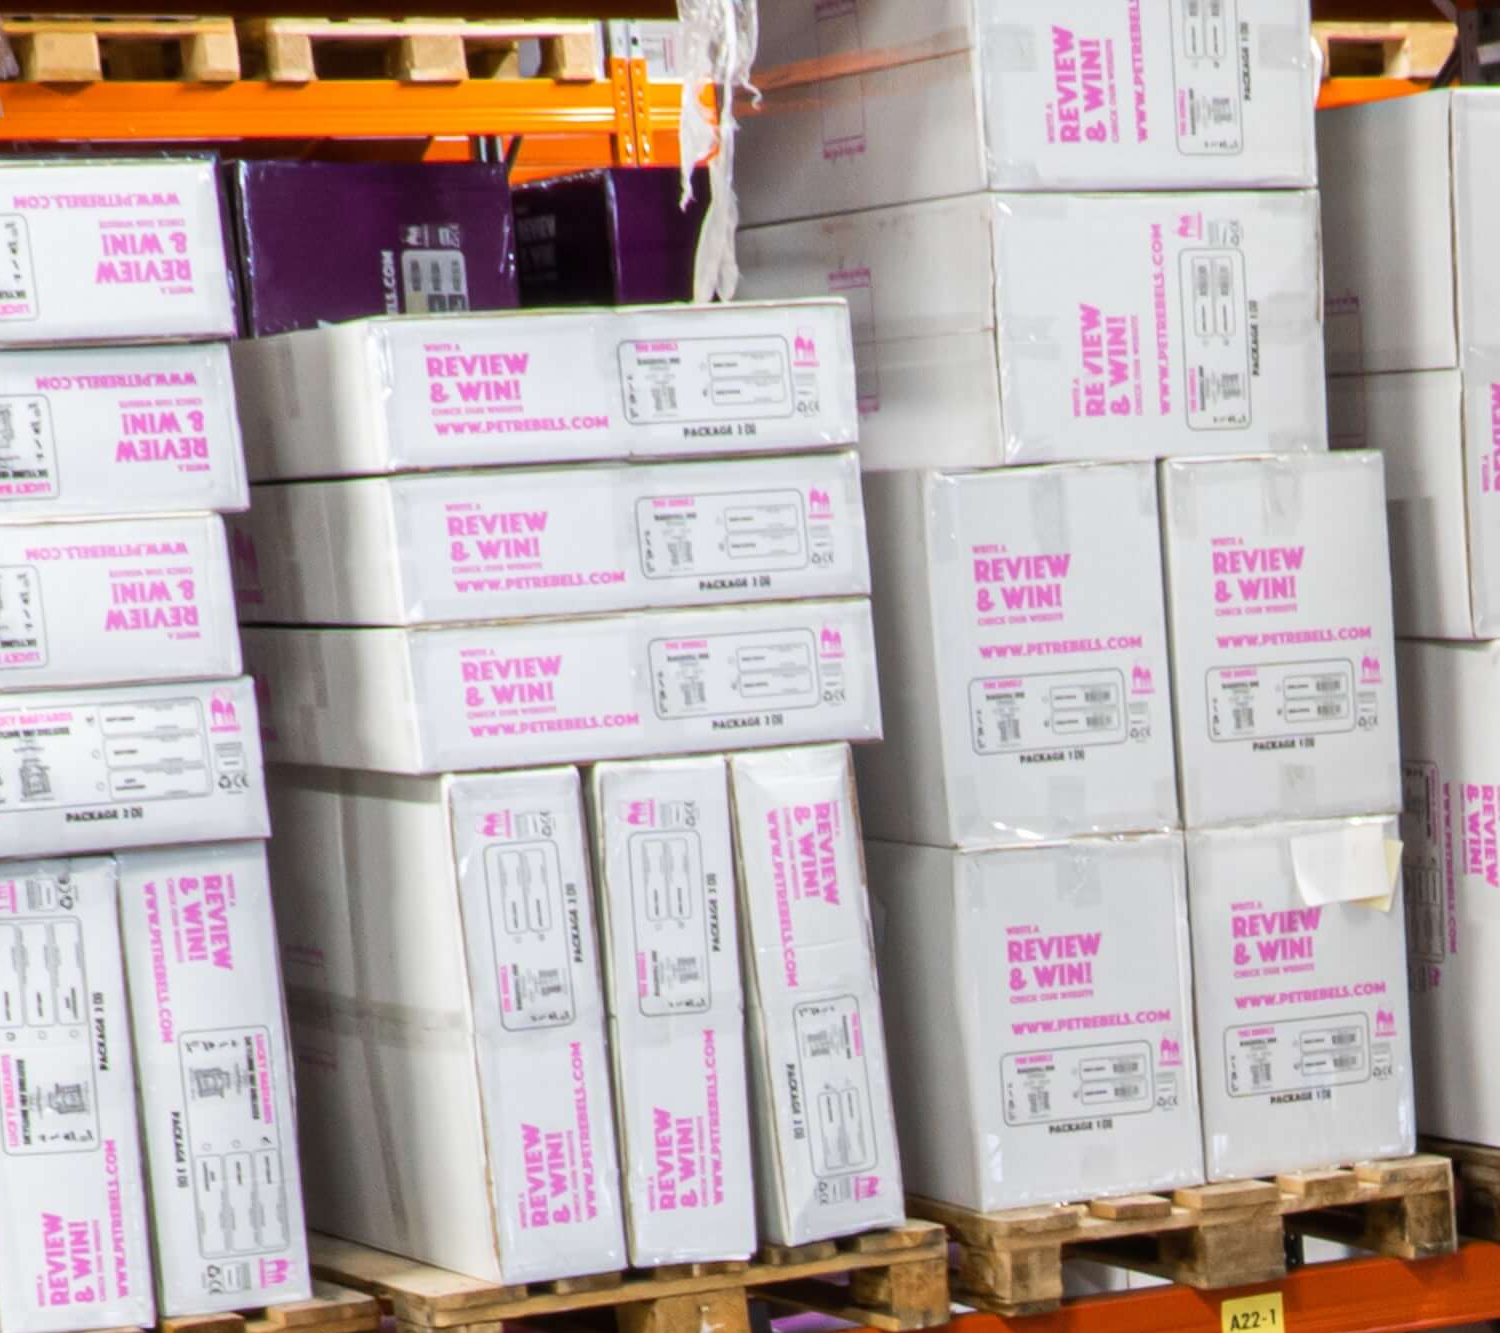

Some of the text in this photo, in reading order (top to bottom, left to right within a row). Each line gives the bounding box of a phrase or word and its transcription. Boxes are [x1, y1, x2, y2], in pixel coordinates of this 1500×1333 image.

[1052, 25, 1081, 143] REVIEW
[1079, 39, 1108, 142] & WIN!
[101, 231, 187, 255] & WIN!
[95, 259, 192, 283] REVIEW
[426, 353, 529, 378] REVIEW
[1080, 304, 1111, 416] REVIEW
[1105, 317, 1131, 416] & WIN!
[430, 380, 520, 404] & WIN!
[125, 410, 204, 433] & WIN!
[436, 416, 609, 435] WWW.PETREBELS.COM
[116, 436, 208, 461] REVIEW
[446, 512, 548, 537] REVIEW
[452, 537, 539, 561] & WIN!
[1212, 545, 1304, 575] REVIEW
[456, 571, 627, 592] WWW.PETREBELS.COM
[974, 555, 1070, 583] REVIEW
[112, 578, 195, 602] & WIN!
[976, 585, 1060, 612] & WIN!
[1214, 576, 1295, 602] & WIN!
[105, 605, 198, 630] REVIEW
[980, 636, 1141, 659] WWW.PETREBELS.COM
[1217, 626, 1372, 649] WWW.PETREBELS.COM
[461, 655, 561, 682] REVIEW
[465, 682, 553, 708] & WIN!
[469, 713, 640, 736] WWW.PETREBELS.COM
[794, 806, 821, 896] & WIN!
[811, 802, 838, 904] REVIEW
[182, 901, 207, 960] WIN!
[202, 874, 232, 969] REVIEW
[1231, 907, 1320, 938] REVIEW
[1007, 934, 1101, 961] REVIEW
[1233, 937, 1312, 966] & WIN!
[1009, 963, 1092, 992] & WIN!
[1236, 982, 1386, 1008] WWW.PETREBELS.COM
[1012, 1010, 1172, 1035] WWW.PETREBELS.COM
[654, 1108, 676, 1210] REVIEW
[676, 1119, 701, 1208] & WIN!
[522, 1125, 549, 1227] REVIEW
[546, 1134, 573, 1224] & WIN!
[42, 1213, 69, 1305] REVIEW
[69, 1223, 90, 1279] WIN!
[1230, 1309, 1276, 1331] A22-1
